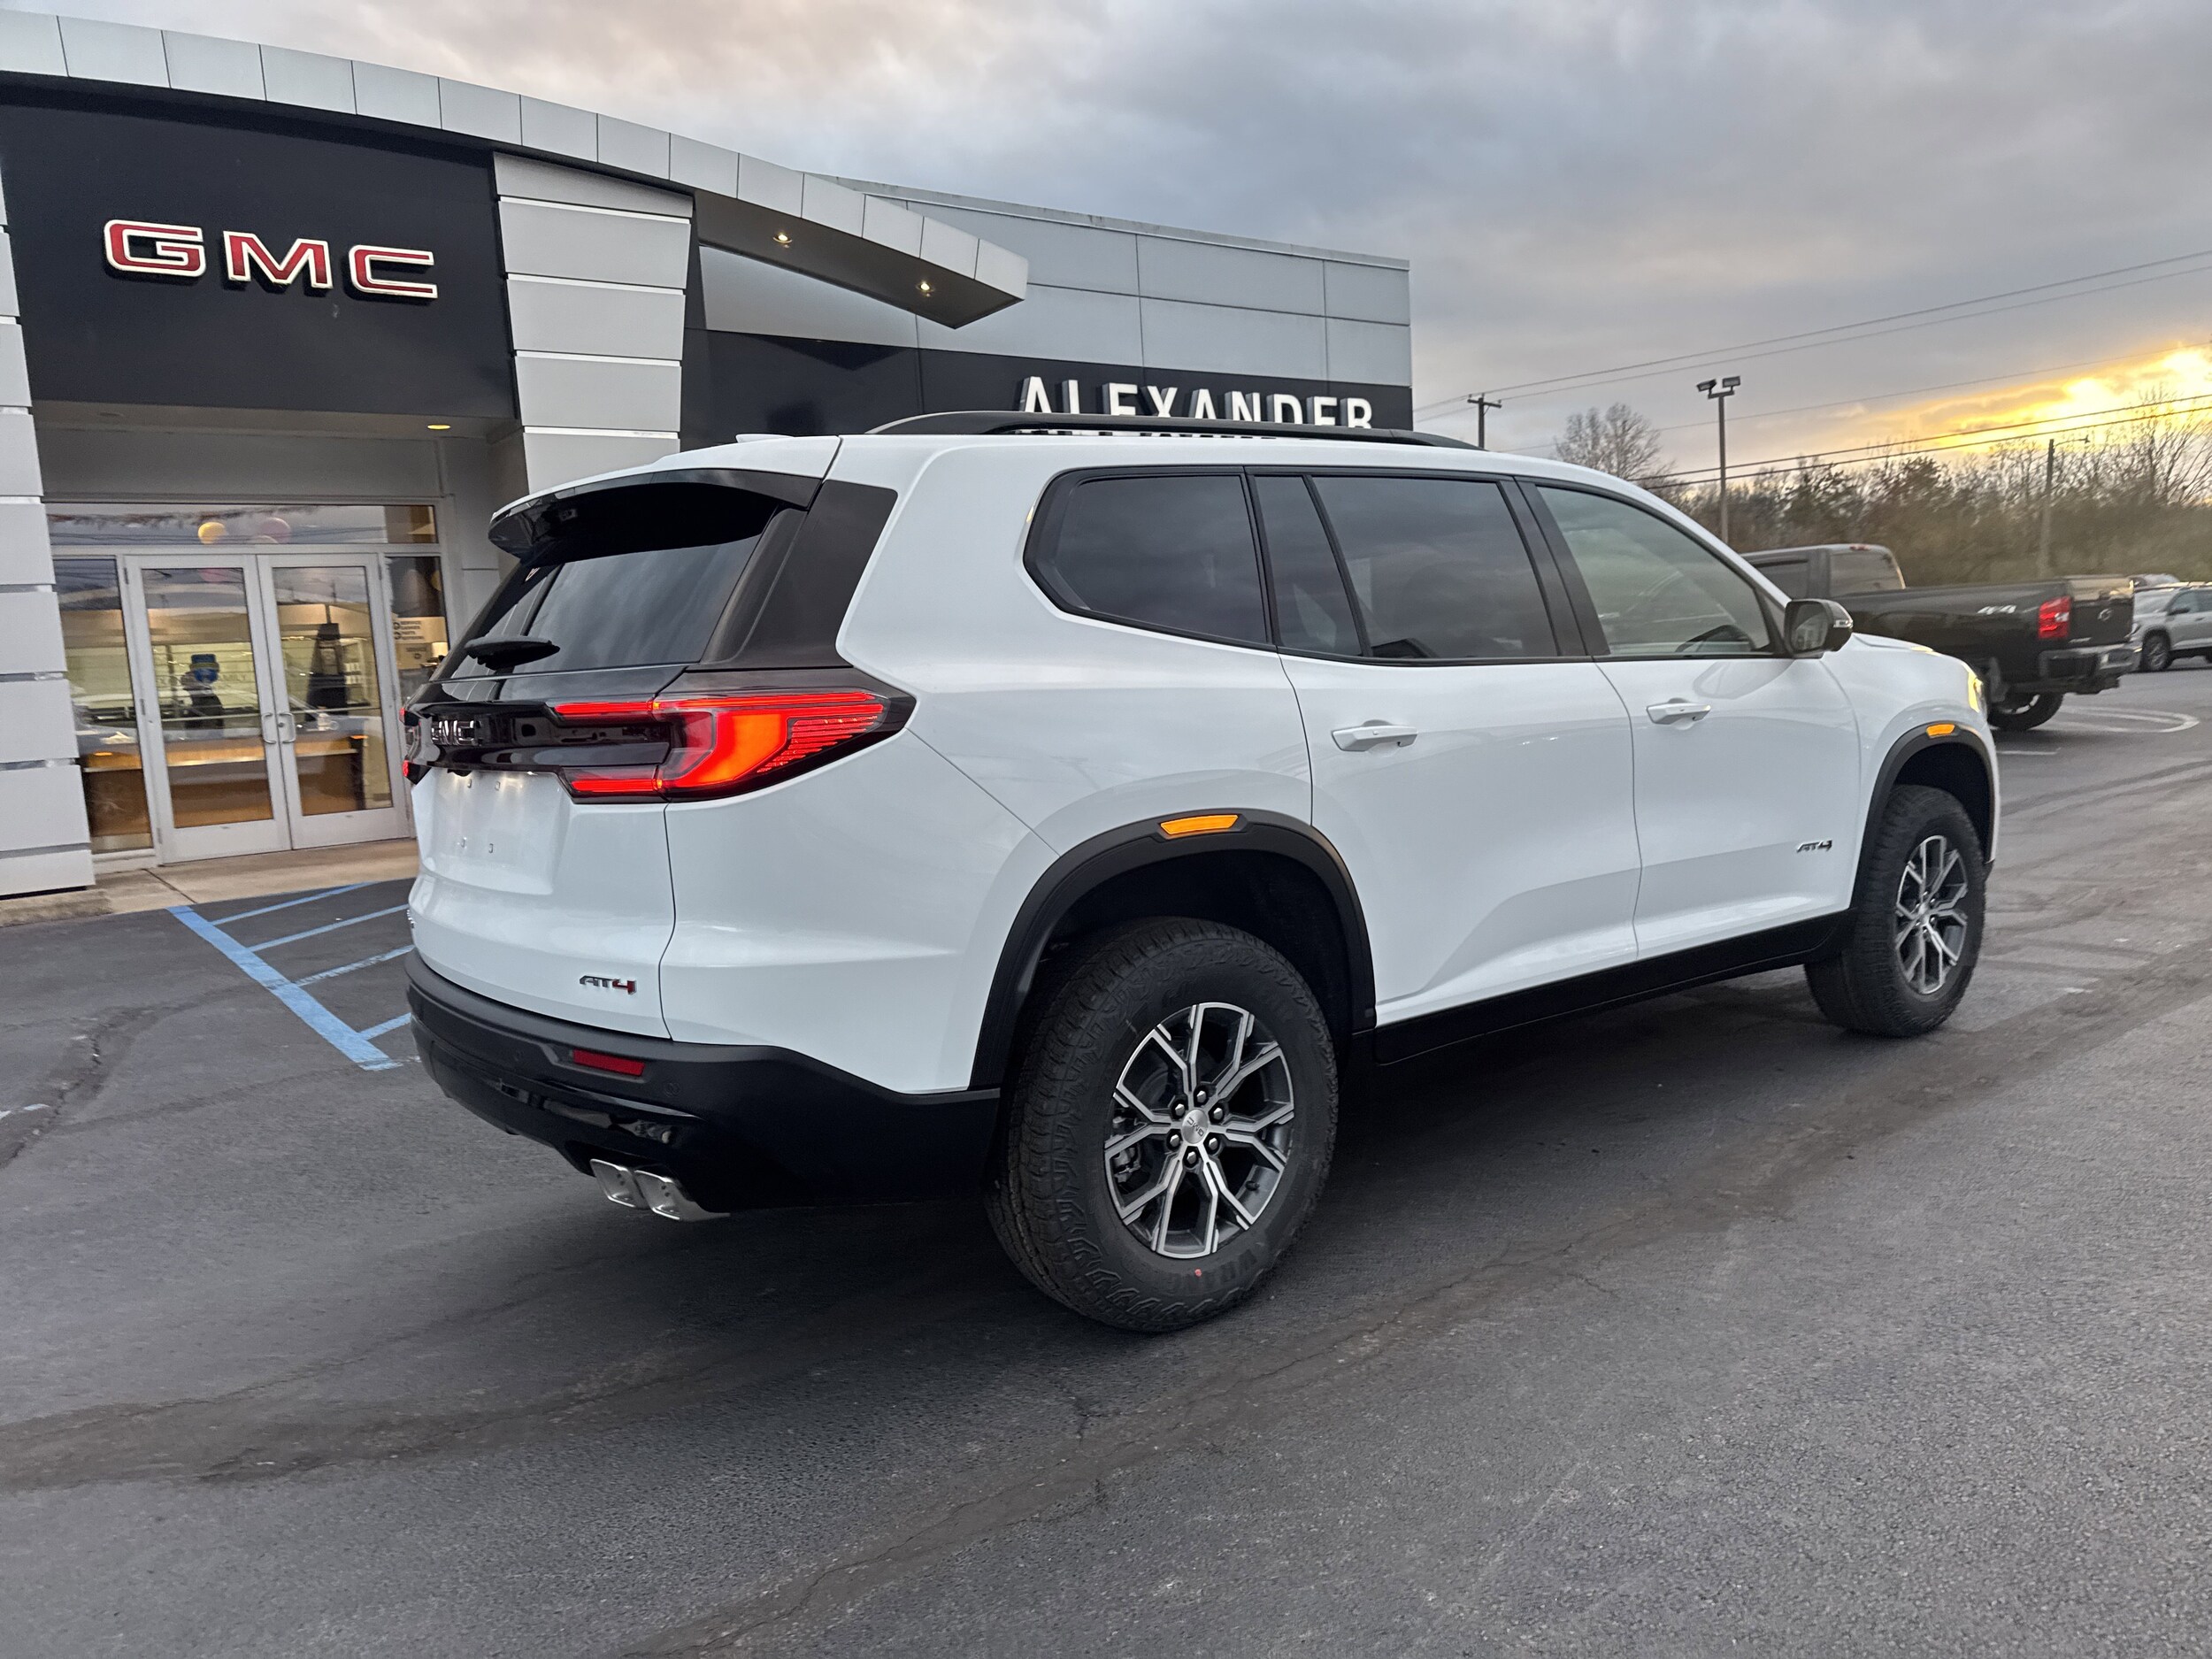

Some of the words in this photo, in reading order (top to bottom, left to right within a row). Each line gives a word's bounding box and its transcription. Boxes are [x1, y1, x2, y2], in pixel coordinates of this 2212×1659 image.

[104, 219, 438, 298] GMC
[1020, 375, 1373, 430] ALEXANDER
[431, 719, 478, 745] GMC
[1796, 839, 1832, 853] AT4
[579, 974, 637, 995] AT4
[1187, 1117, 1204, 1137] GMC
